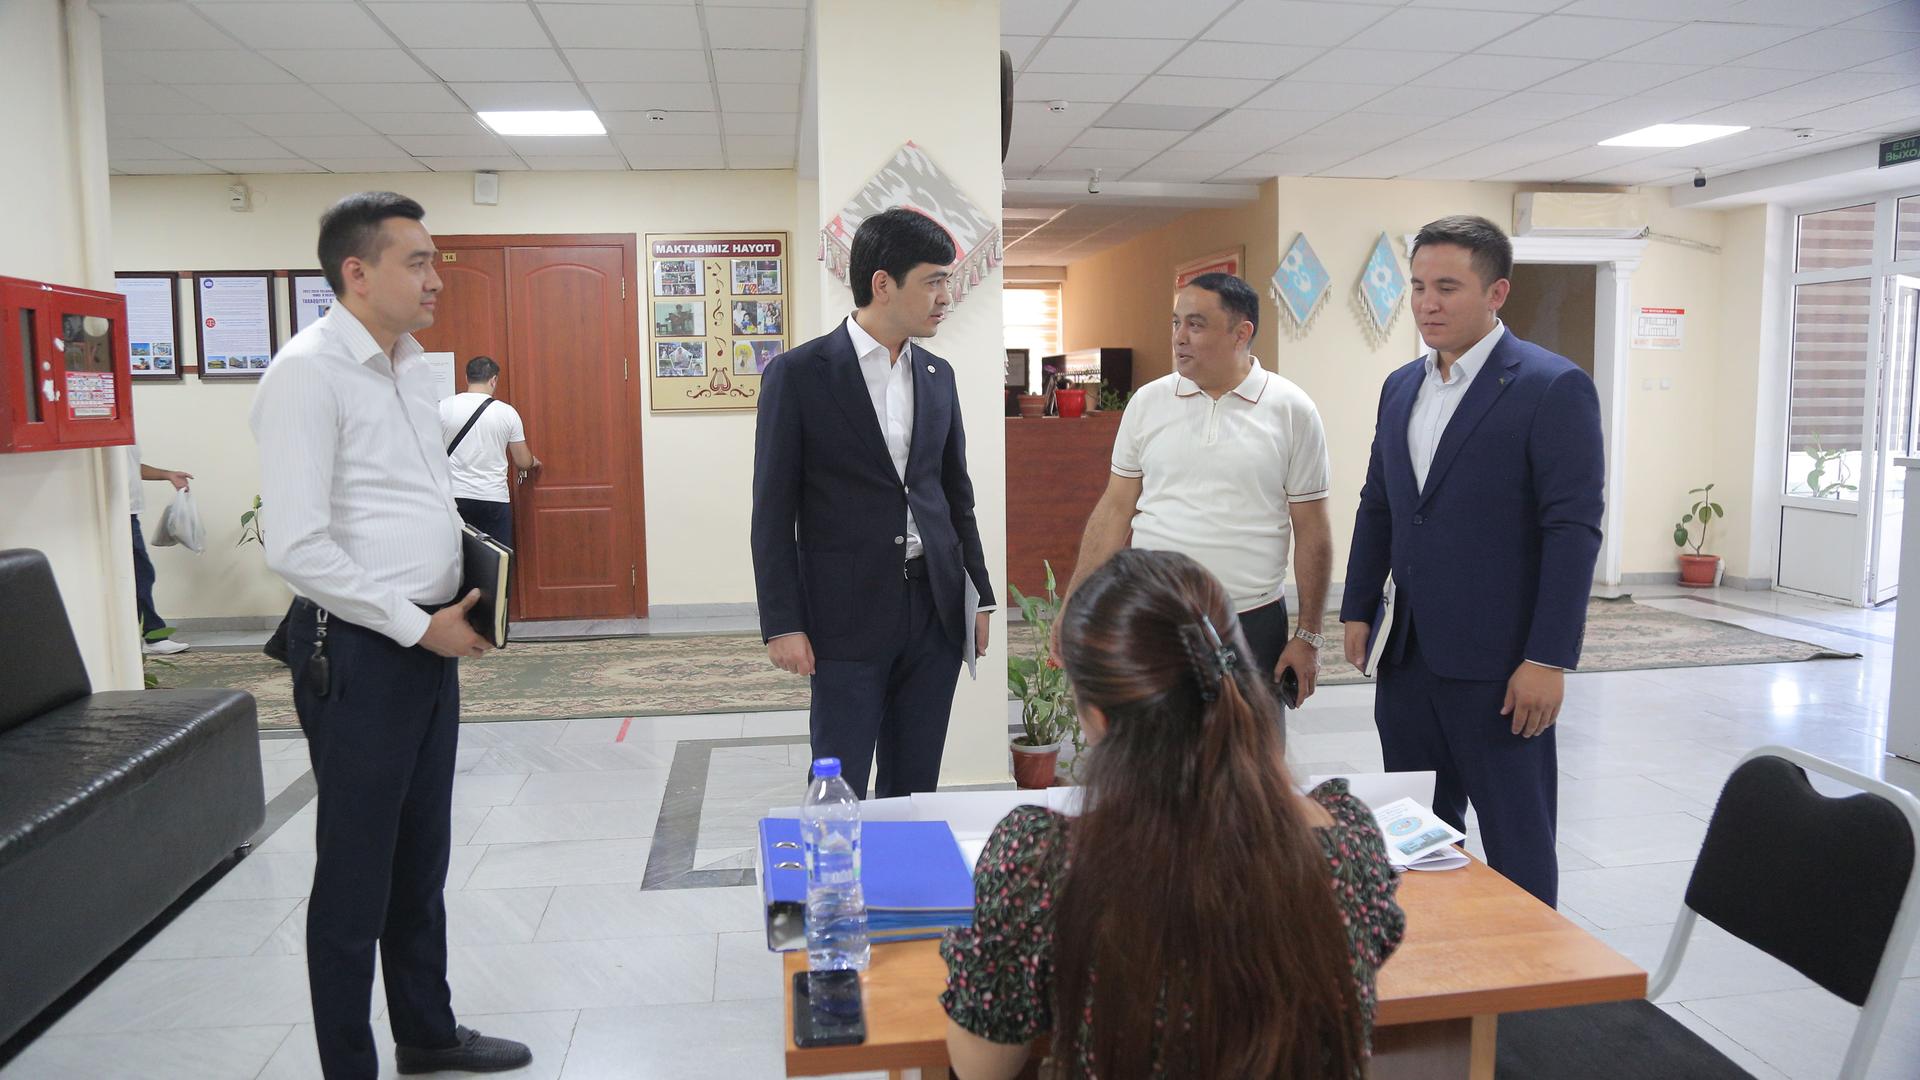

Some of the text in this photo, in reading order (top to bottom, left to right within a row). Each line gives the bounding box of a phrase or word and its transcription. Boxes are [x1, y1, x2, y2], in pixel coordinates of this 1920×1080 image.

[1892, 138, 1917, 151] EXIT
[656, 244, 775, 254] MAKTABIMIZ HAYOTI
